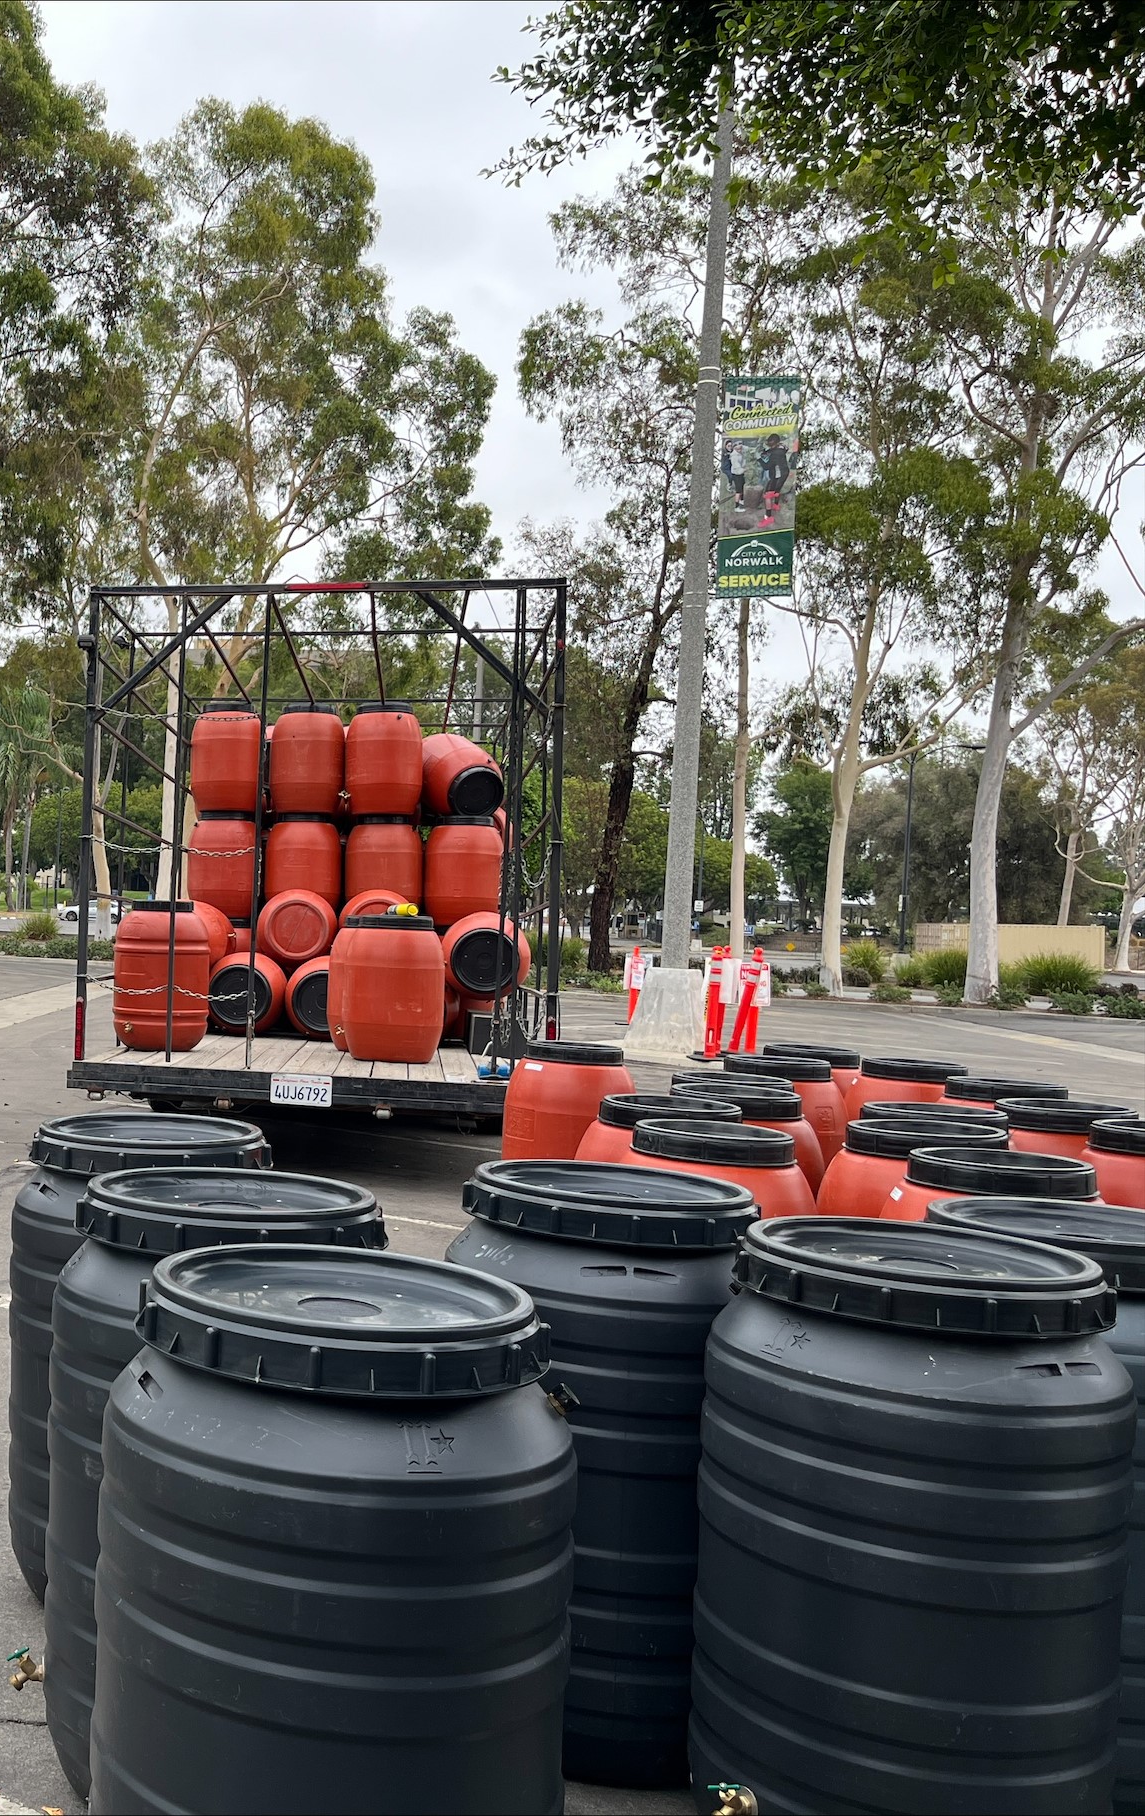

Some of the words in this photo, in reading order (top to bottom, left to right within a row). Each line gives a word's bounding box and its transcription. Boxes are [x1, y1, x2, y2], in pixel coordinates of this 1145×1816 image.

[731, 402, 793, 420] Connected
[725, 415, 795, 431] COMMUNITY
[725, 556, 784, 567] NORWALK
[718, 573, 790, 588] SERVICE
[274, 1084, 328, 1103] 4UJ6792
